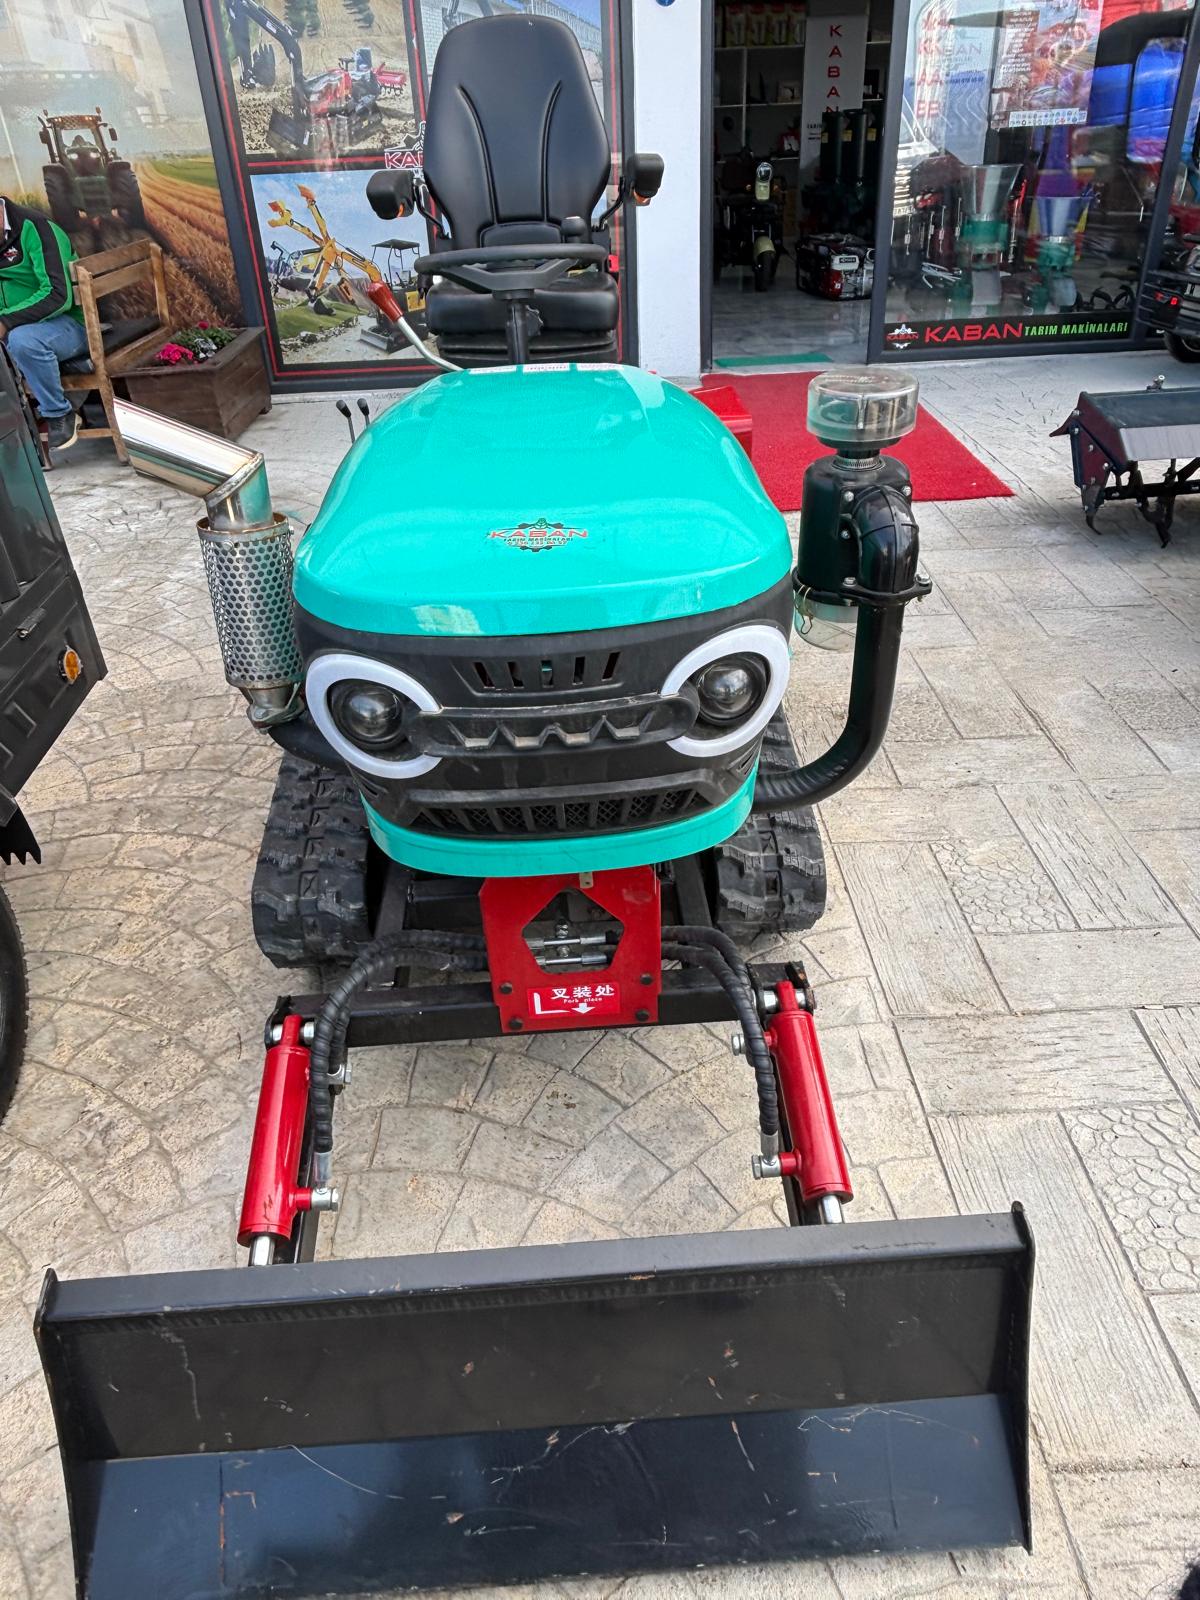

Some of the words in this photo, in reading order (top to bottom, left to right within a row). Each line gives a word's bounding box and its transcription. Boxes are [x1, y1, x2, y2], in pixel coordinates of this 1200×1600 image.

[924, 322, 1023, 343] KABAN
[1024, 325, 1059, 337] TARIM
[1061, 321, 1129, 335] MAKİNALARI
[490, 529, 588, 539] KABAN
[550, 984, 616, 1000] 叉装处
